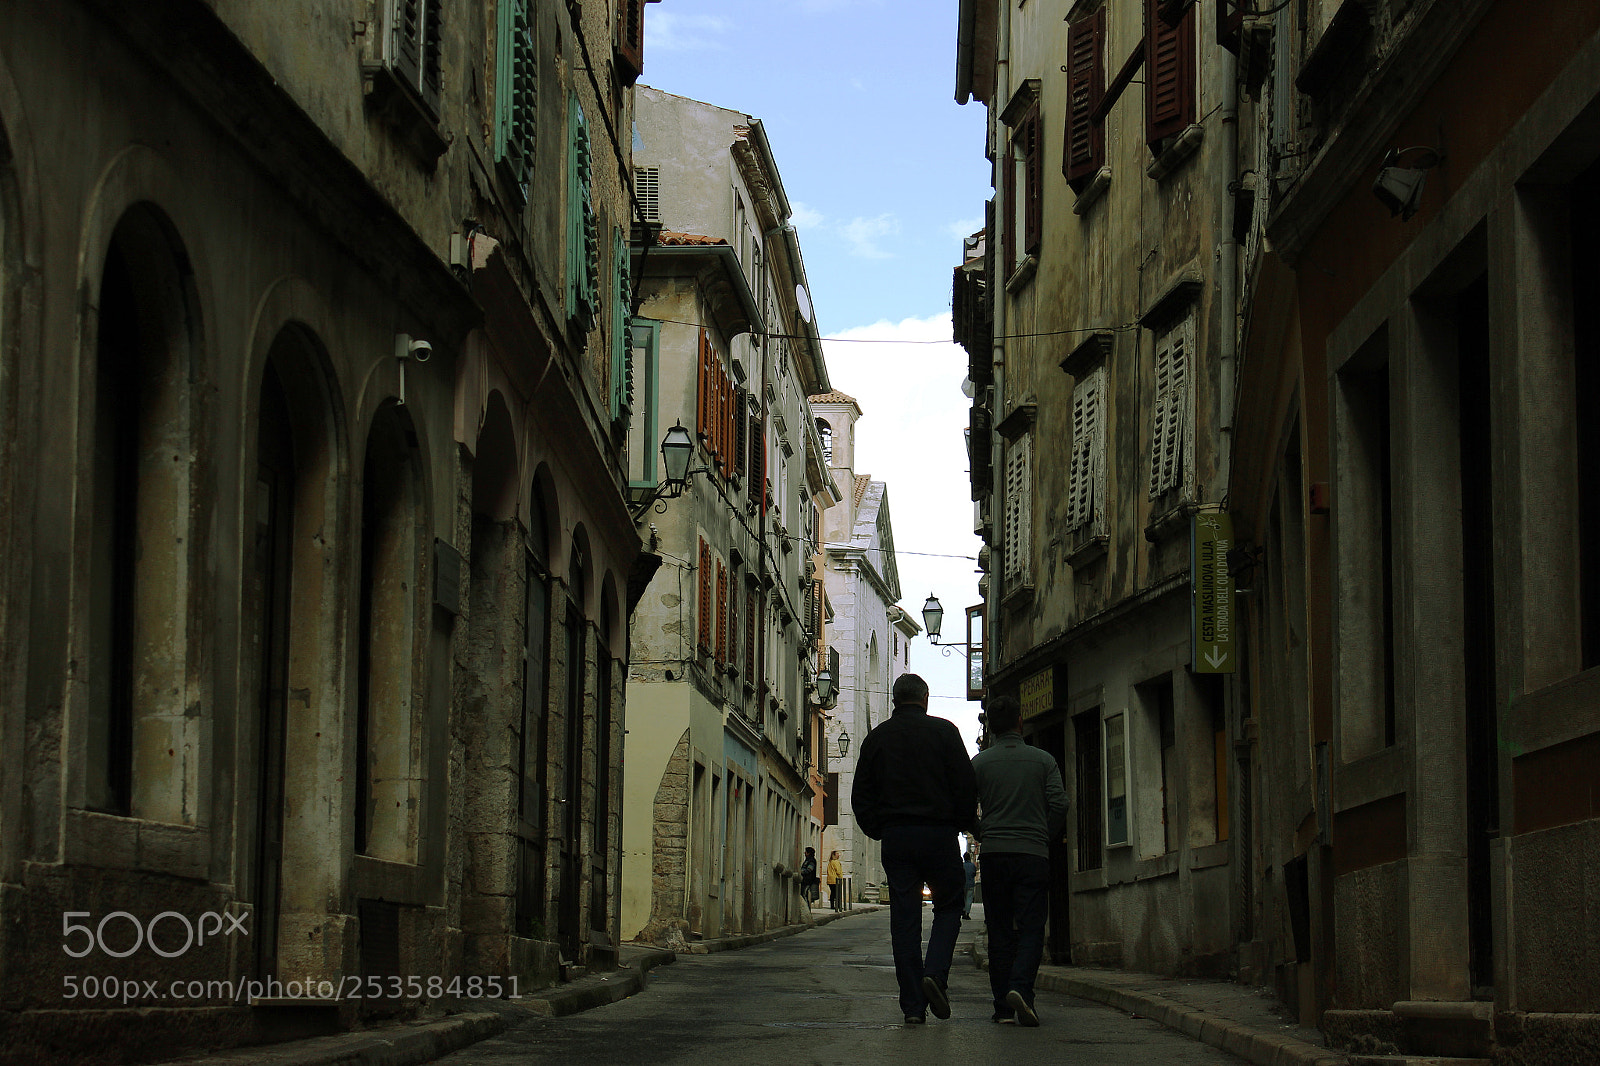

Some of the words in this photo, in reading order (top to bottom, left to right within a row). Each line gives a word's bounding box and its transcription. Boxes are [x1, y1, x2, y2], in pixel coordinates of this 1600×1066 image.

[1202, 540, 1213, 561] ULJA
[1202, 563, 1214, 613] MASLINOVA
[1216, 568, 1229, 585] OLIO
[1202, 616, 1214, 642] CESTA
[1217, 605, 1229, 632] STRADA
[1217, 633, 1229, 642] LA
[1022, 691, 1053, 717] PANIFICIO
